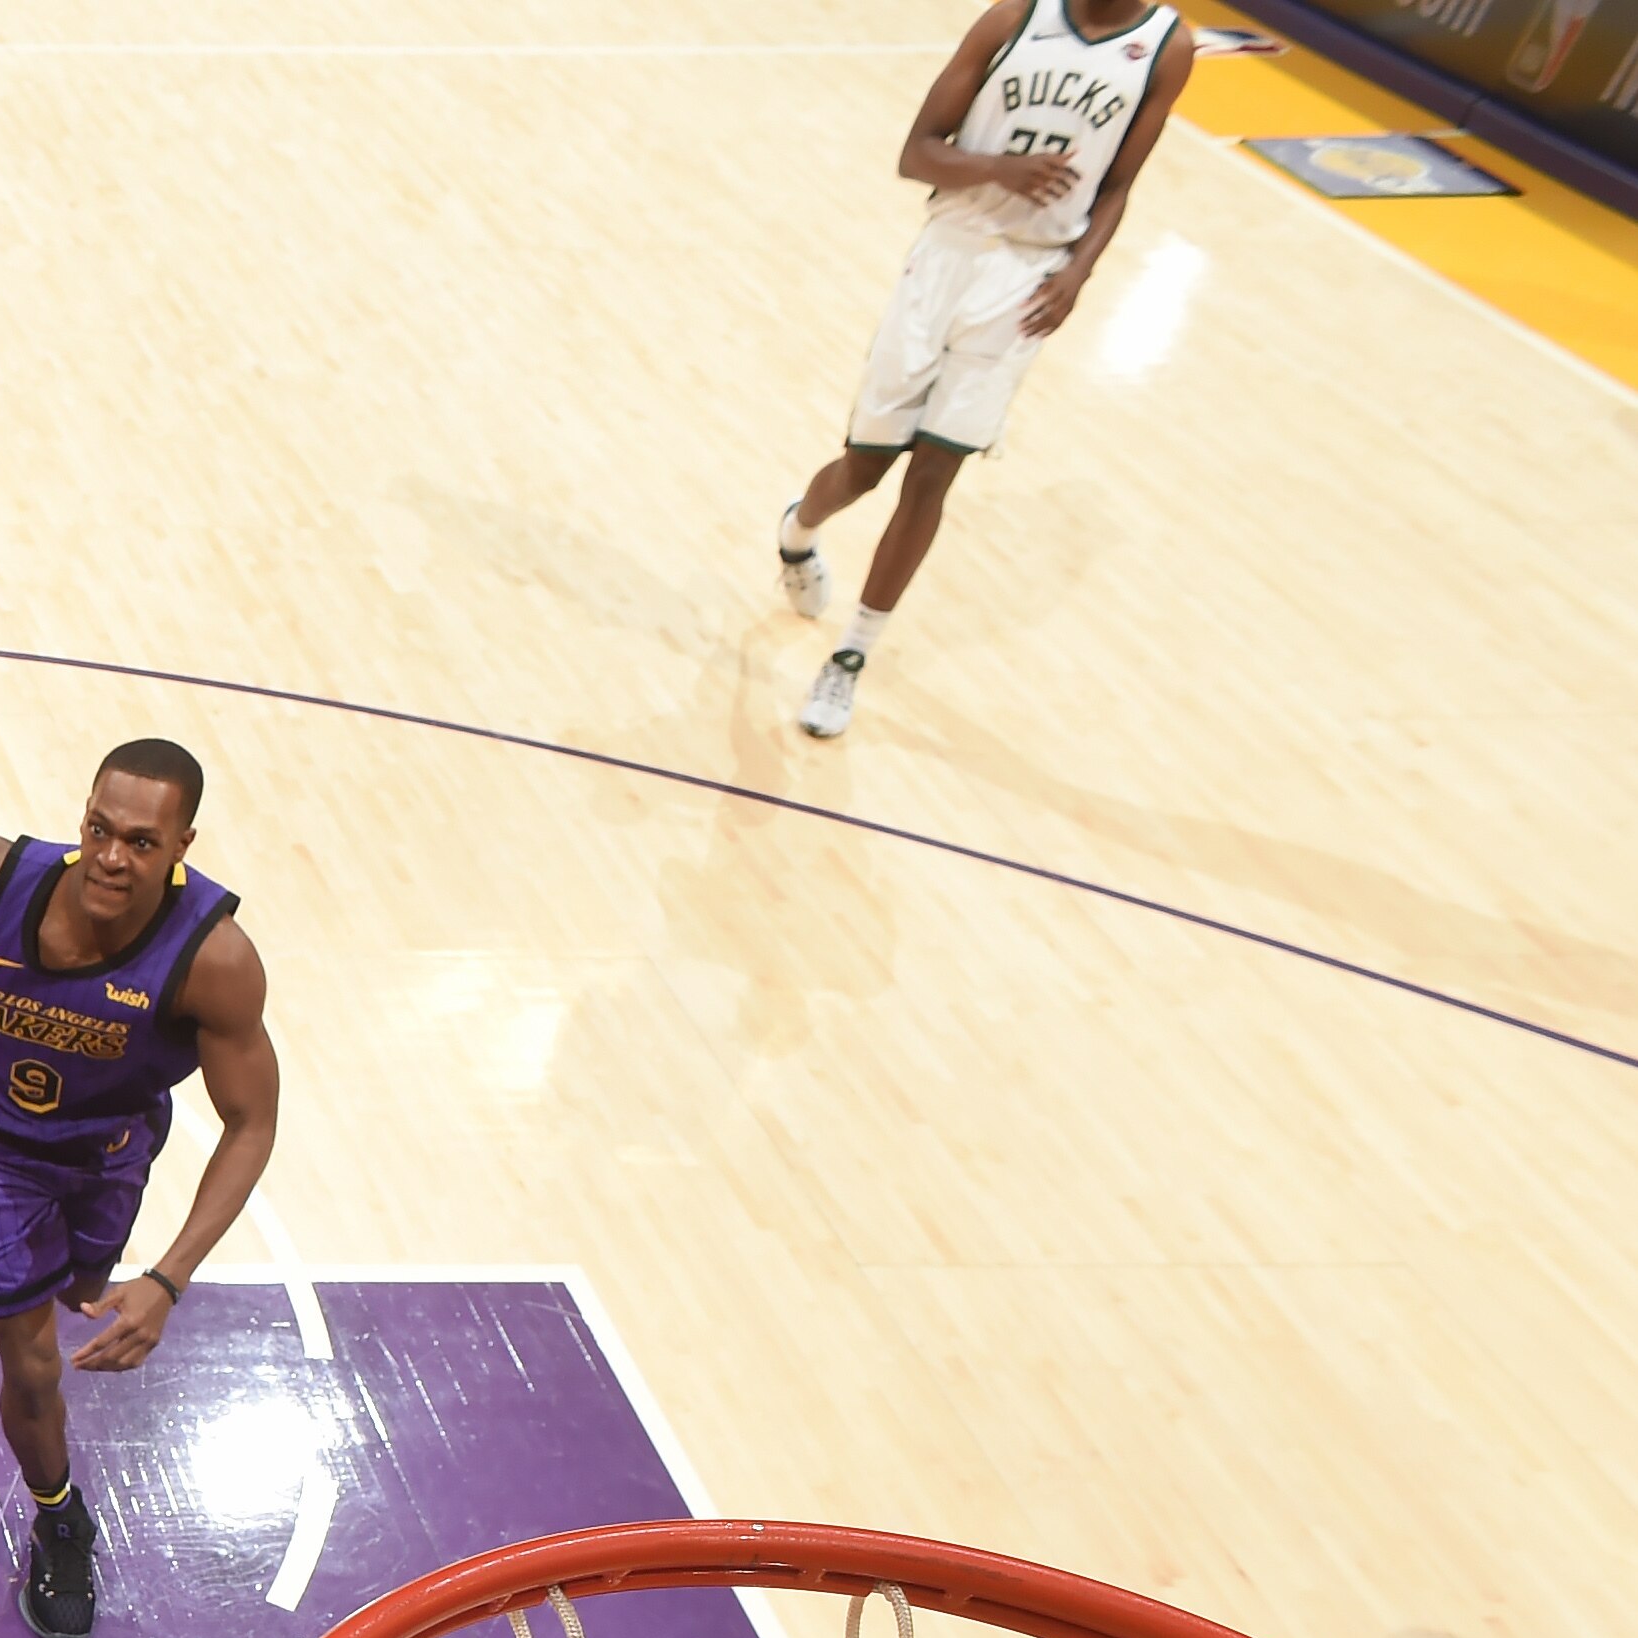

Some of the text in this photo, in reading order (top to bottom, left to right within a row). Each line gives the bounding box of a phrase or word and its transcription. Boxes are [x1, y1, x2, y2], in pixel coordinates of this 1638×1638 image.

[1003, 70, 1125, 129] BUCKS
[4, 993, 131, 1035] LOS ANGELES
[105, 982, 151, 1010] wish
[8, 1058, 63, 1114] 9
